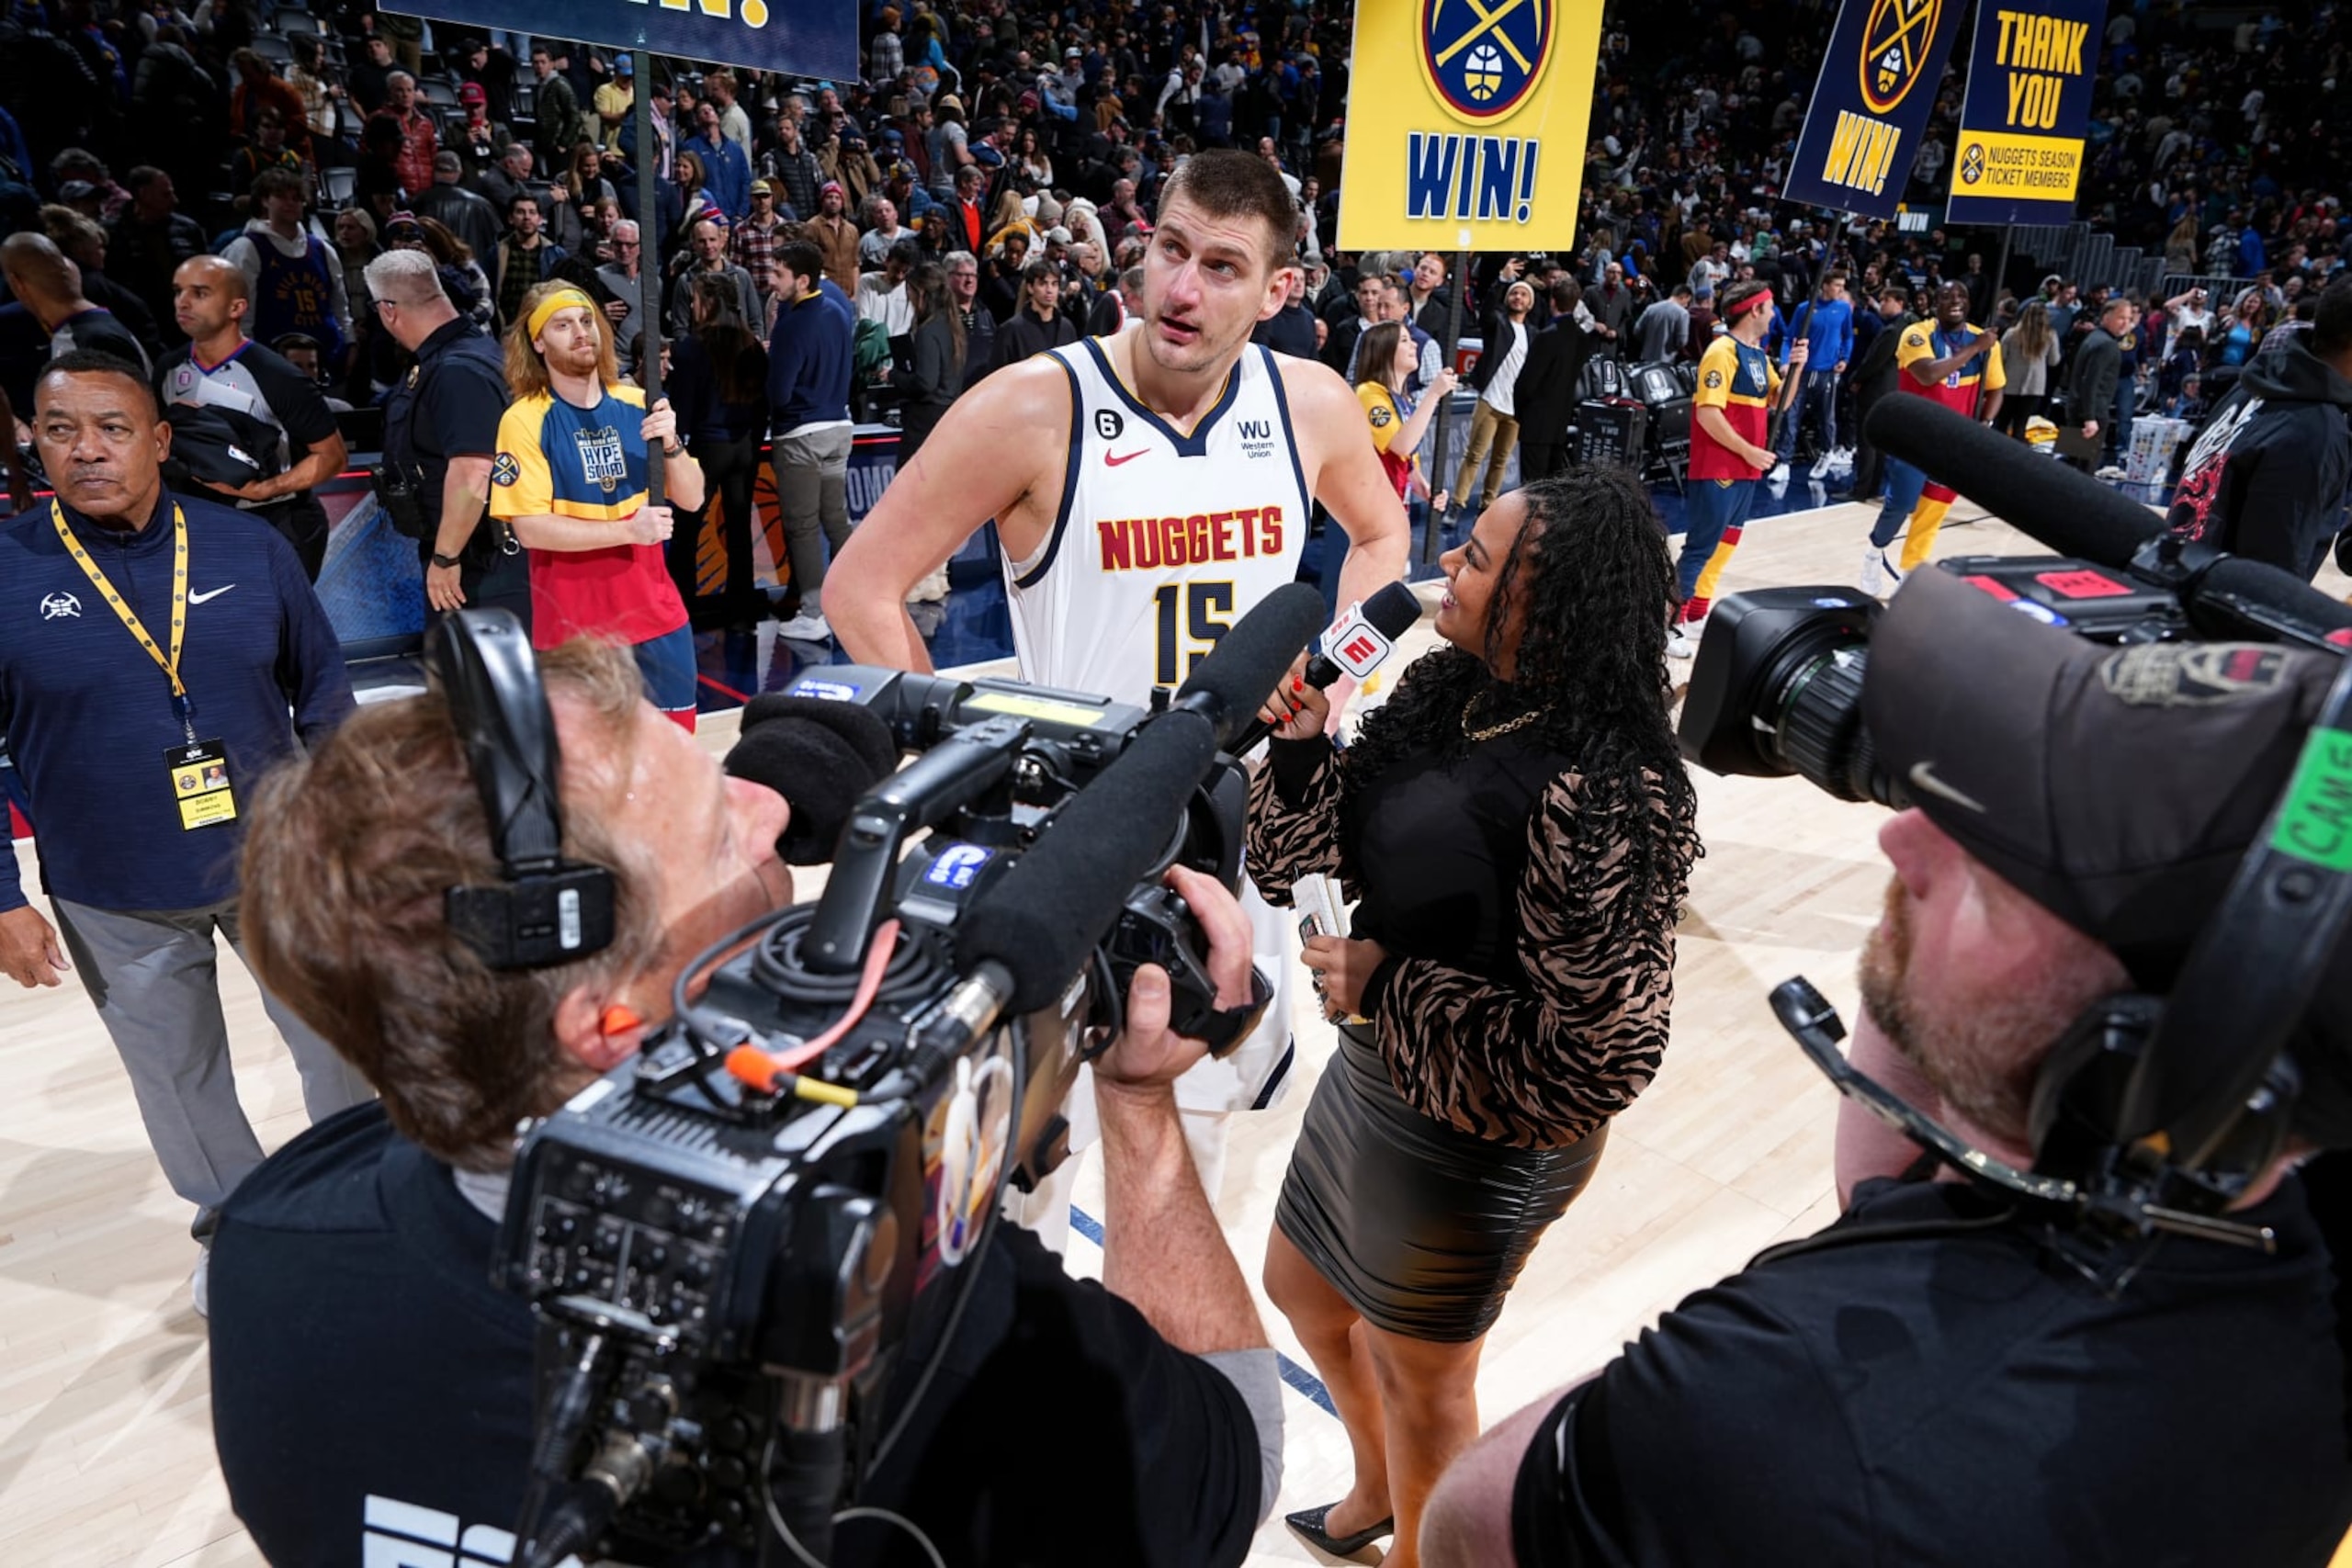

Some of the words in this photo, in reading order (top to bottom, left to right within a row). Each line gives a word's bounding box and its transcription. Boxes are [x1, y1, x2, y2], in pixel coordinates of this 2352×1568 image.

[1996, 9, 2089, 75] THANK
[2007, 72, 2064, 130] YOU
[1822, 109, 1902, 197] WIN!
[1988, 146, 2037, 166] NUGGETS
[2038, 150, 2076, 169] SEASON
[1405, 130, 1541, 225] WIN!
[1985, 167, 2023, 186] TICKET
[2023, 170, 2071, 189] MEMBERS
[1898, 211, 1929, 232] WIN
[1238, 420, 1272, 440] WU
[582, 444, 621, 465] HYPE
[1240, 441, 1275, 452] Western
[1247, 449, 1272, 459] Union
[587, 462, 624, 479] SQUAD
[1096, 505, 1283, 573] NUGGETS
[1152, 580, 1234, 687] 15
